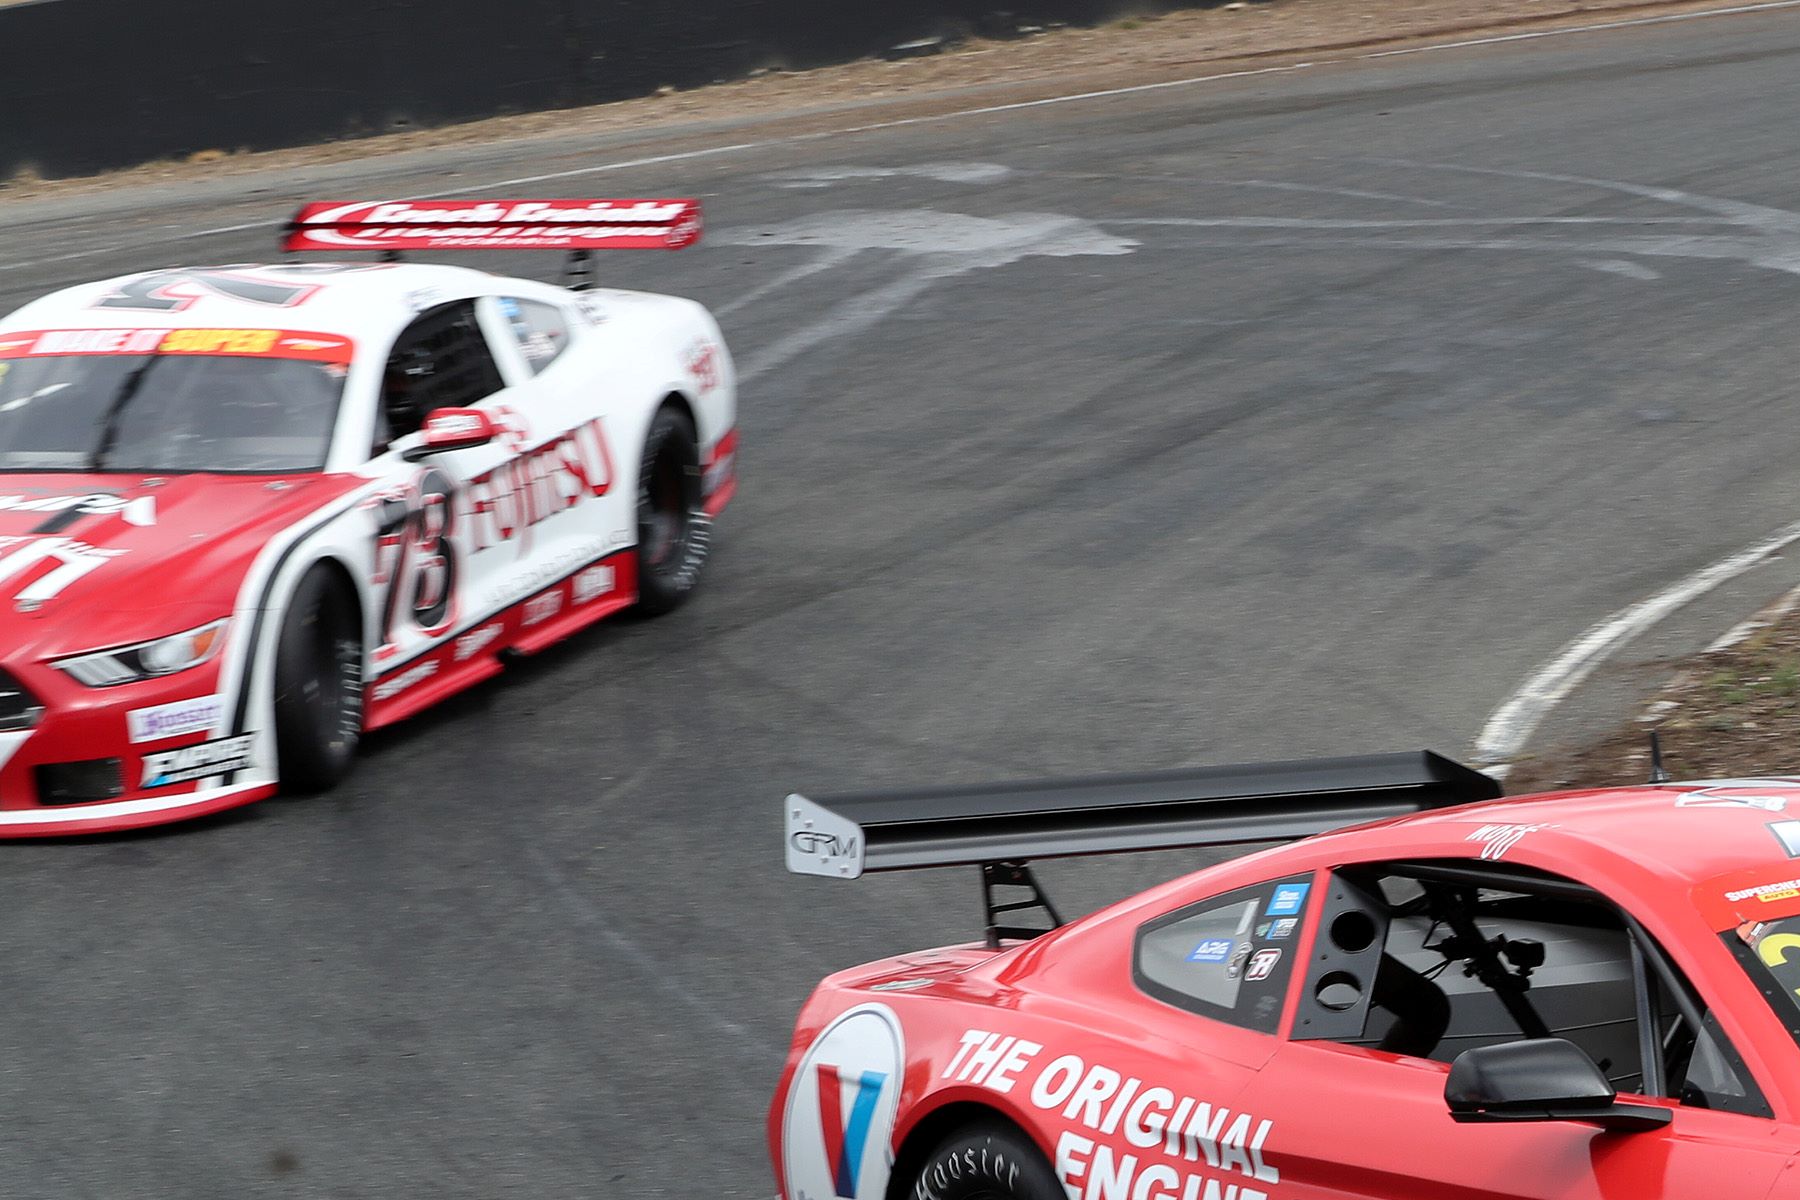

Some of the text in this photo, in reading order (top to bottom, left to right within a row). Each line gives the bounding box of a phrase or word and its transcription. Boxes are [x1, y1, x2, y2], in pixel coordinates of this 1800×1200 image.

[1764, 891, 1795, 900] AUTO
[941, 1029, 1281, 1184] THE ORIGINAL
